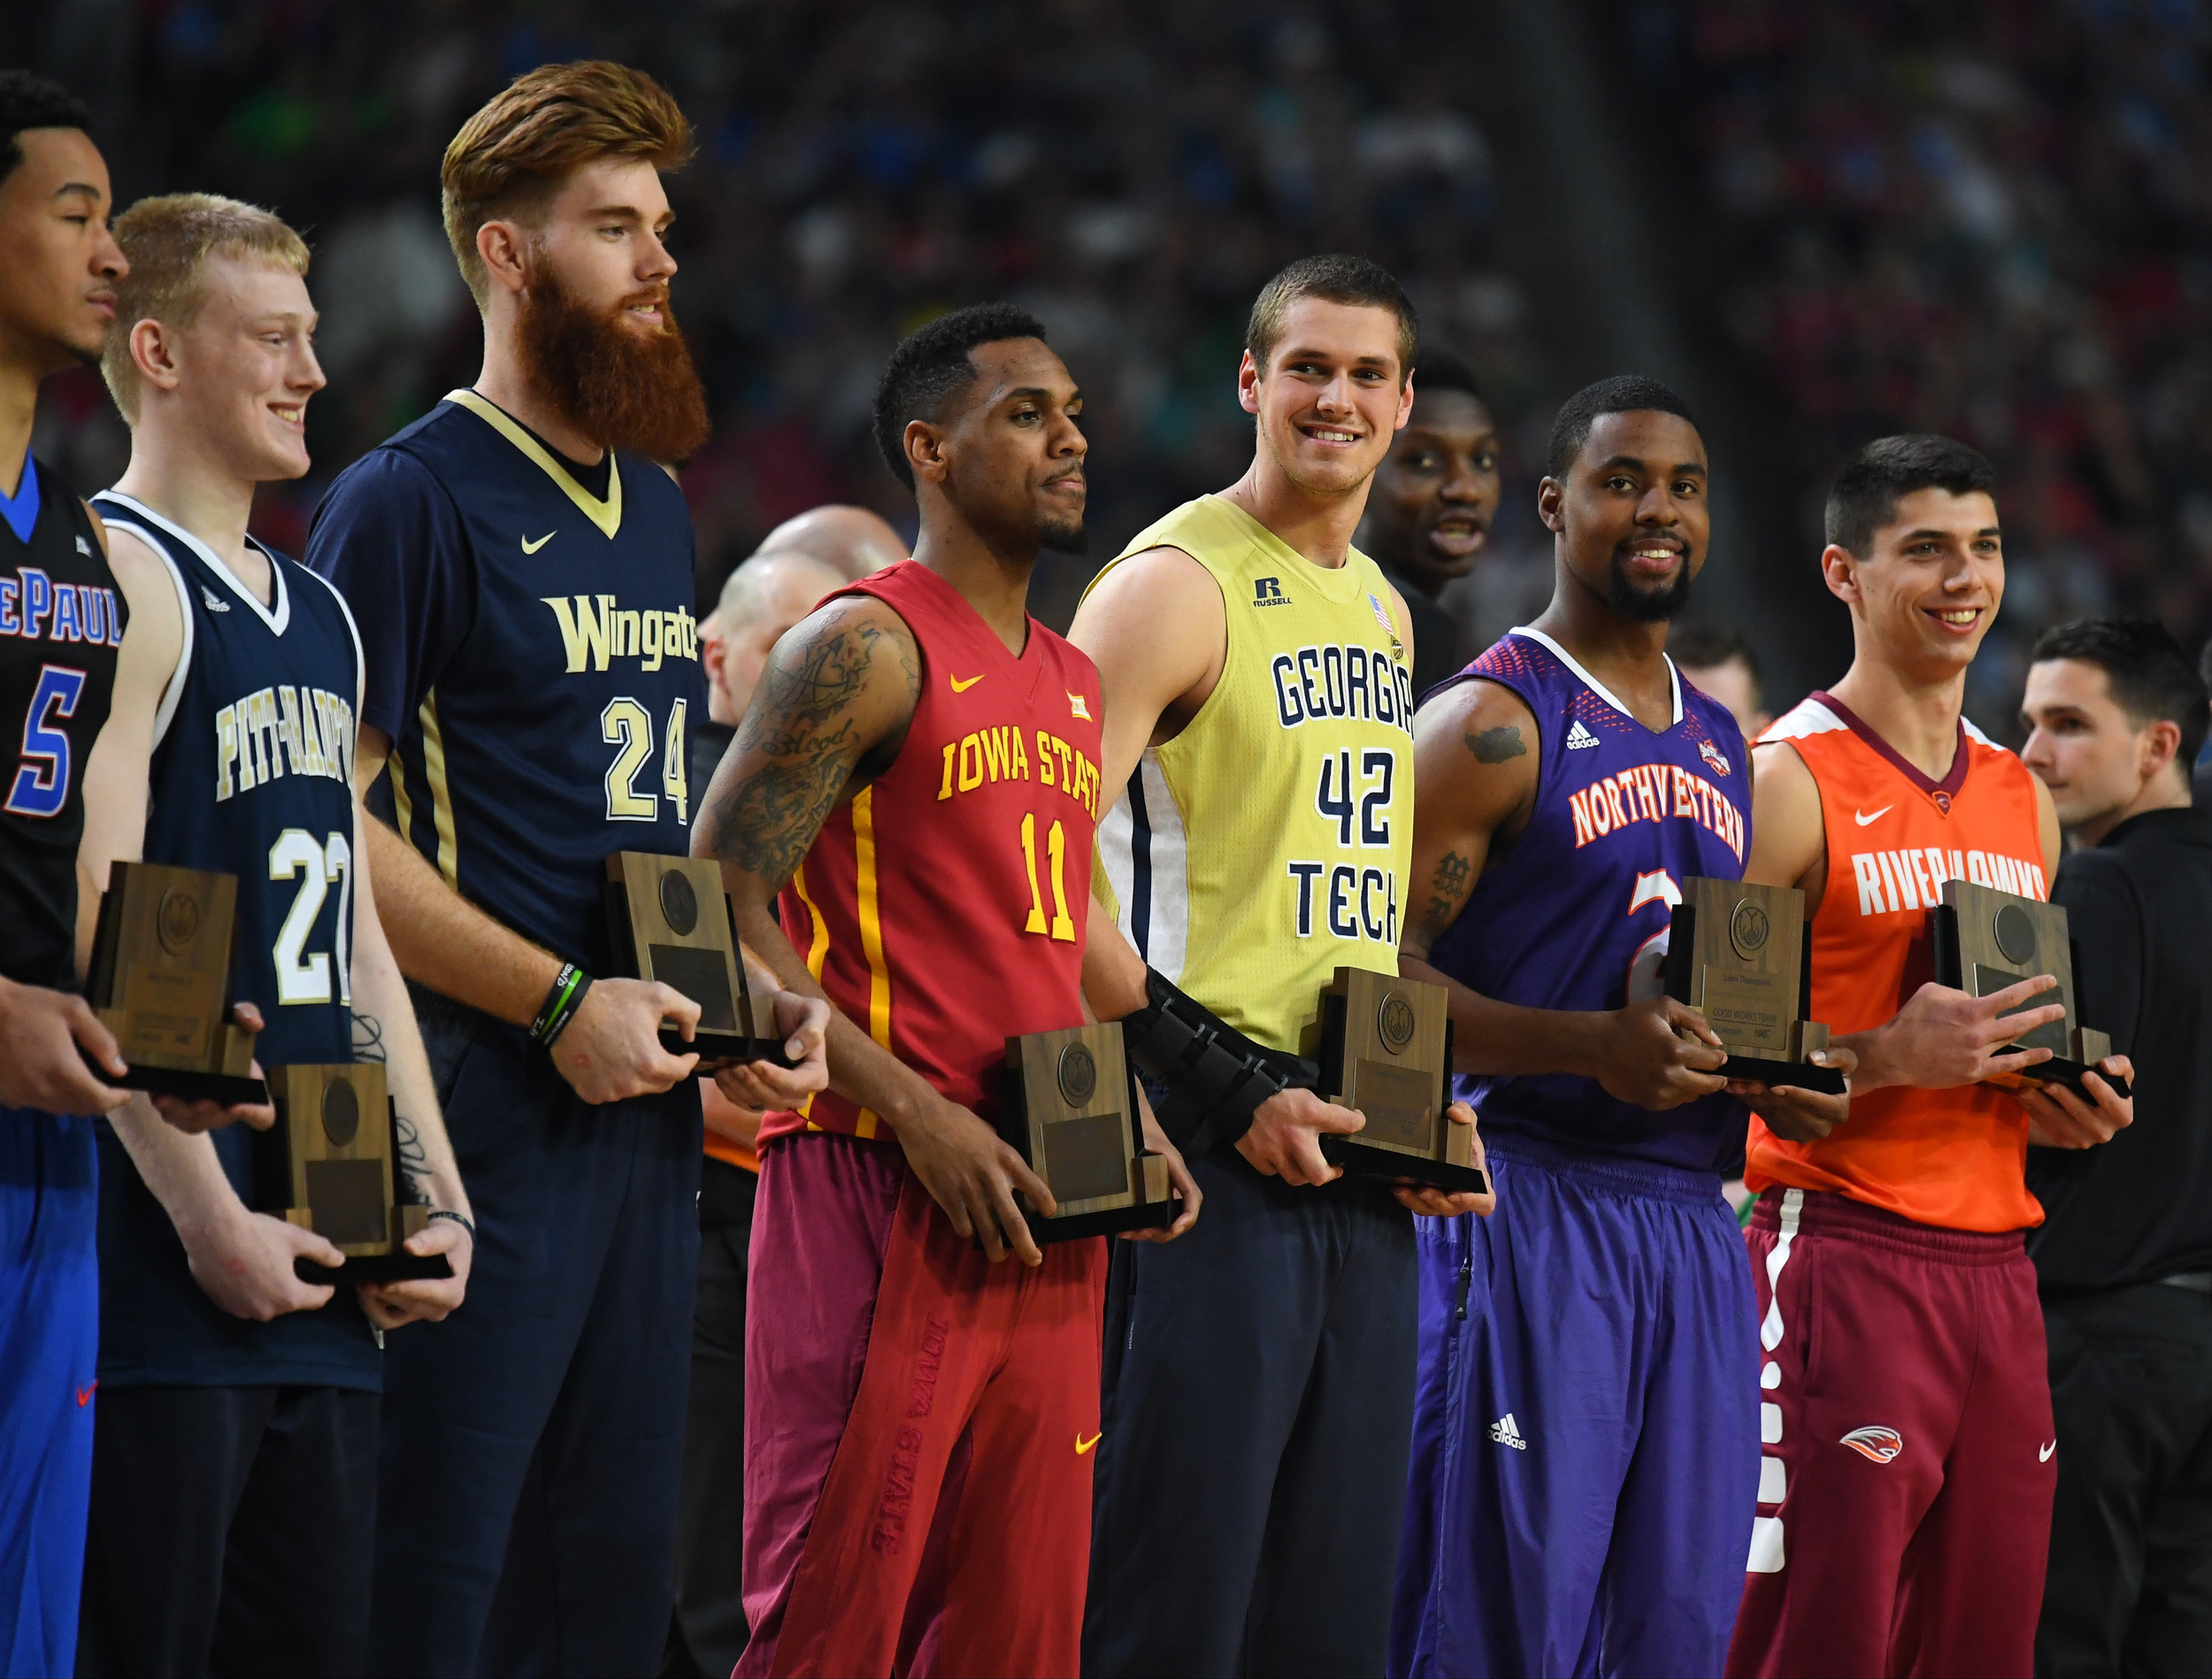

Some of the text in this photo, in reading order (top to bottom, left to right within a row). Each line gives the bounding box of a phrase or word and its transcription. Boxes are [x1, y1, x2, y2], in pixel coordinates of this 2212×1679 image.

[0, 566, 122, 648] EPAUL
[1253, 597, 1292, 608] RUSSELL
[3, 663, 87, 817] 5
[1271, 643, 1414, 742] GEORGIA
[601, 696, 687, 825] 24
[937, 725, 1102, 823] IOWA STAT
[1566, 737, 1601, 750] adidas
[1314, 746, 1395, 849] 42
[1020, 811, 1076, 943] 11
[1286, 860, 1398, 946] TECH
[1487, 1430, 1526, 1451] adidas
